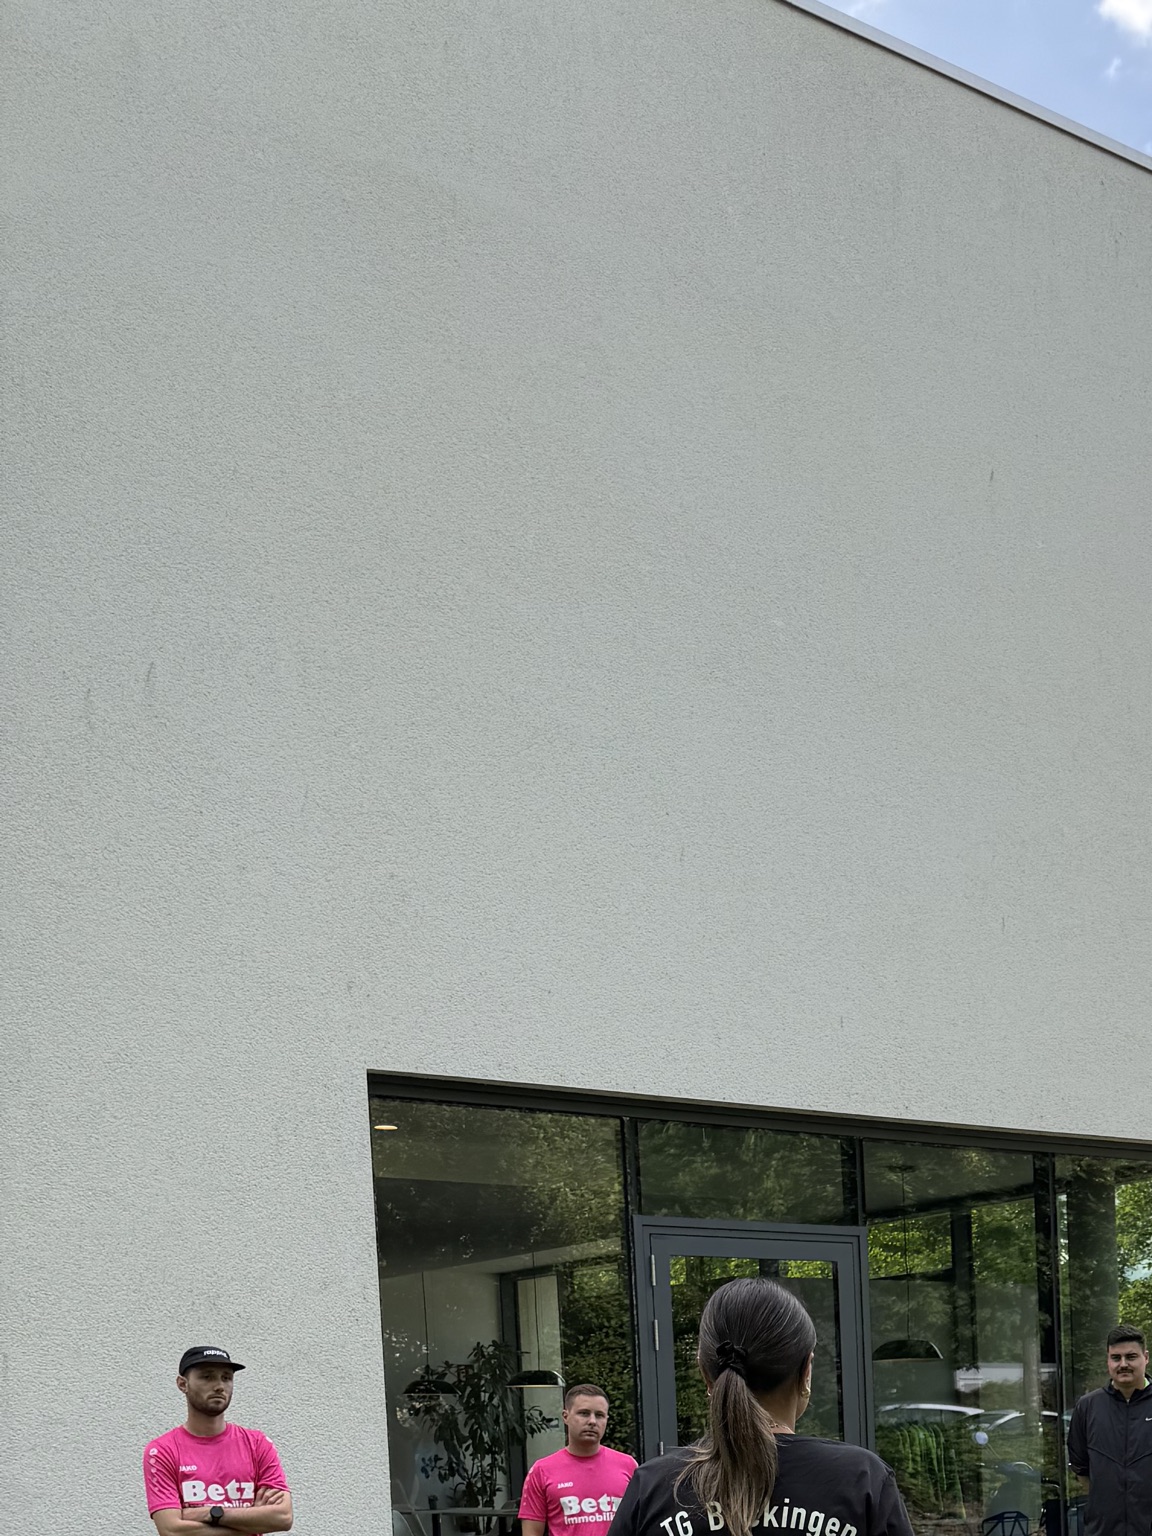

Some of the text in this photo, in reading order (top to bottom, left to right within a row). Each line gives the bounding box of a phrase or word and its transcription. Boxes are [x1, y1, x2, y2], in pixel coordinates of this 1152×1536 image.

[181, 1478, 255, 1503] Betz
[557, 1481, 574, 1489] JAKO
[564, 1512, 616, 1525] Immobili
